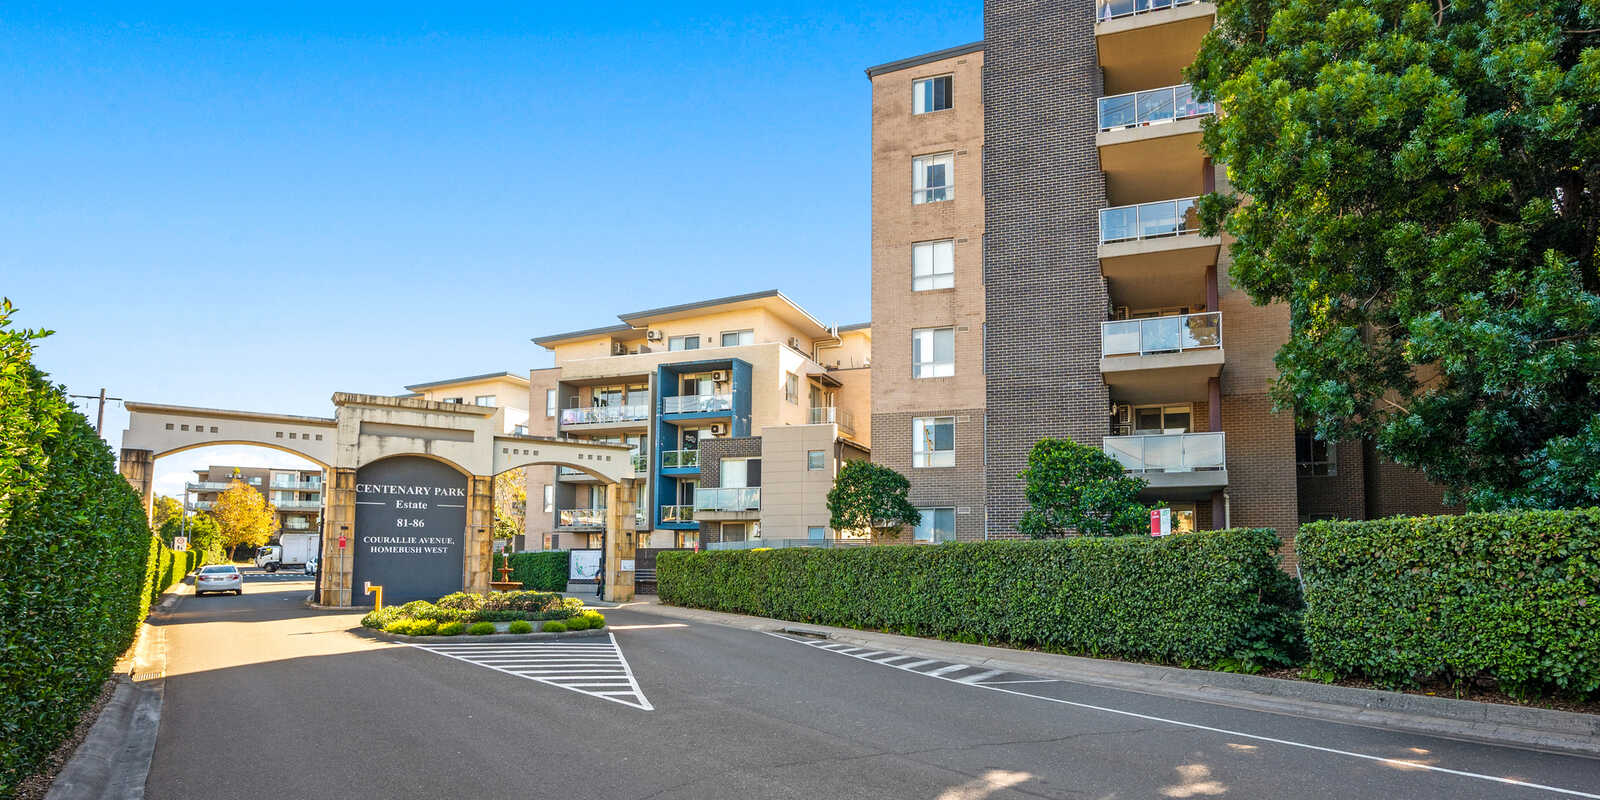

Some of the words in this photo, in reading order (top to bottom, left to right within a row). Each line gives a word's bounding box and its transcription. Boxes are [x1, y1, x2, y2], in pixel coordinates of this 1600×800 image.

[355, 483, 431, 496] CENTENARY
[434, 487, 465, 497] PARK
[395, 500, 428, 509] Estate
[396, 518, 425, 528] 81-86
[363, 536, 417, 544] COURALLIE
[418, 537, 455, 545] AVENUE,
[370, 546, 422, 554] HOMEBUSH
[423, 546, 448, 554] WEST
